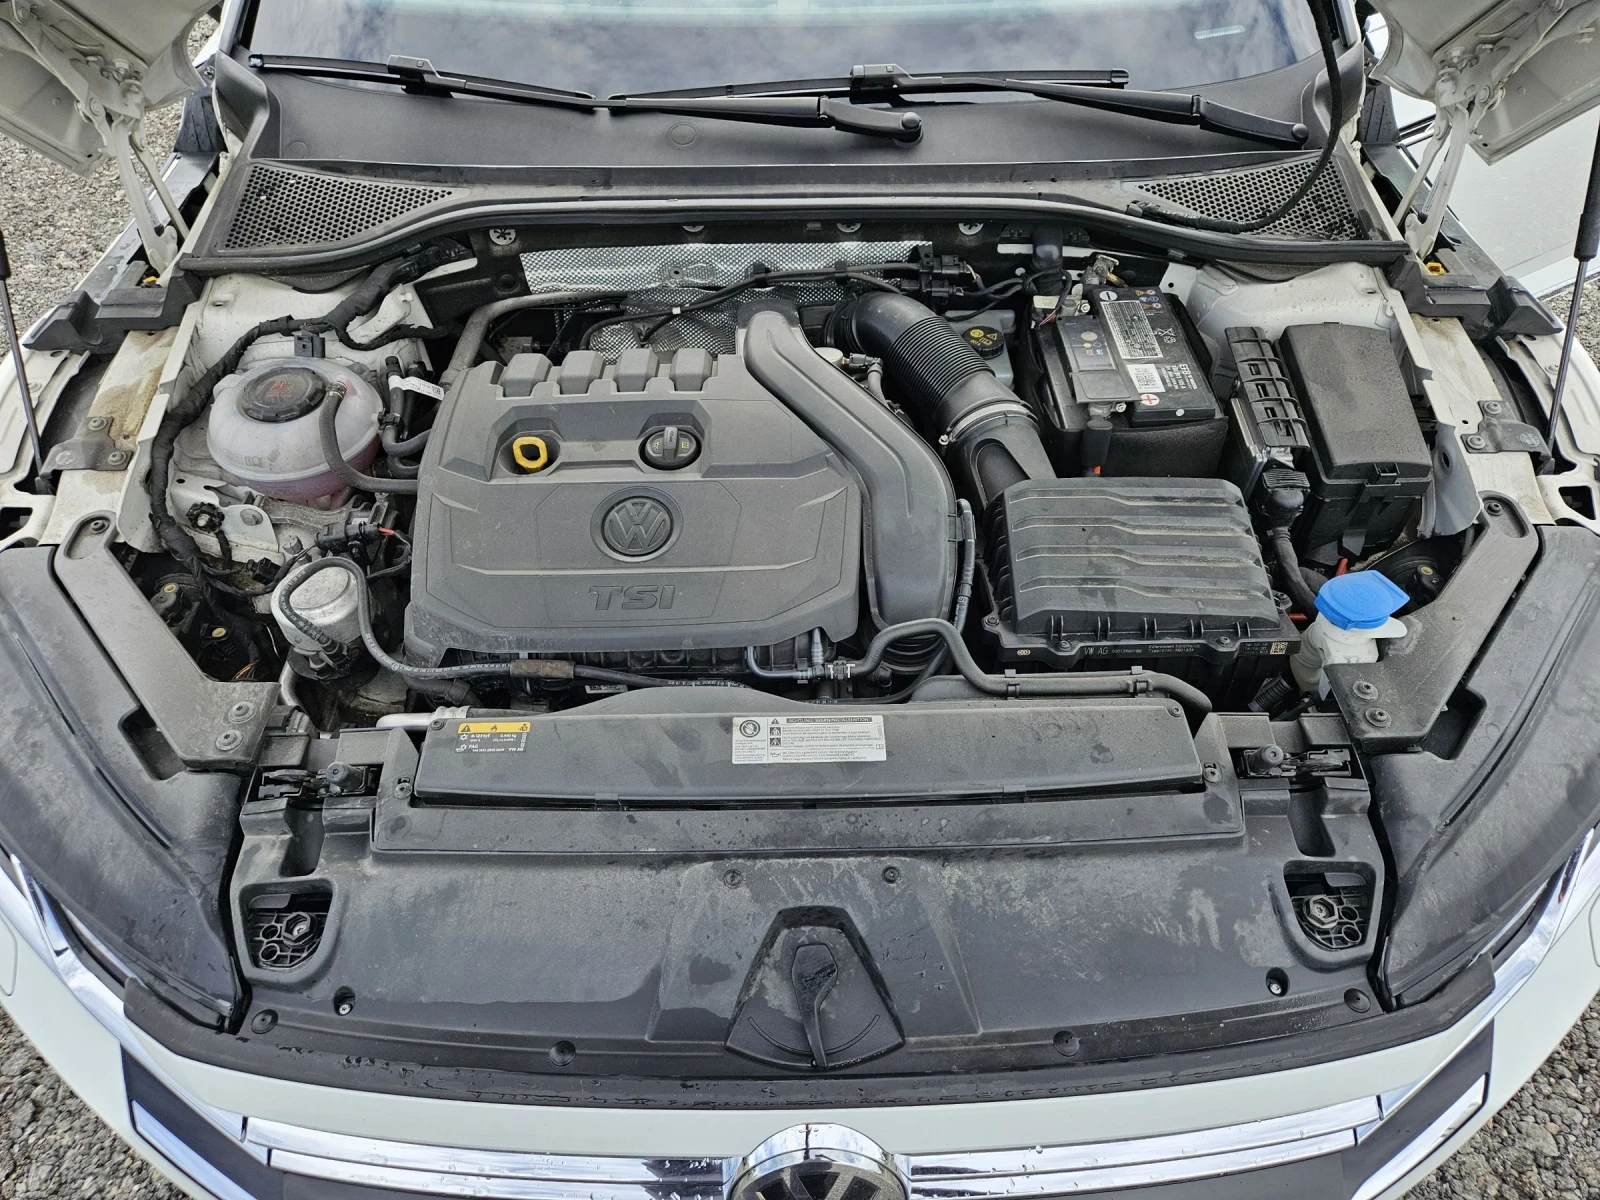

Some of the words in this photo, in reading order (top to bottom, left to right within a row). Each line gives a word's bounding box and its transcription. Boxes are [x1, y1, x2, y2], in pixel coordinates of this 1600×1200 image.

[605, 499, 670, 553] VW
[589, 585, 676, 610] TSI
[1084, 647, 1095, 655] VW
[1097, 646, 1109, 655] AG
